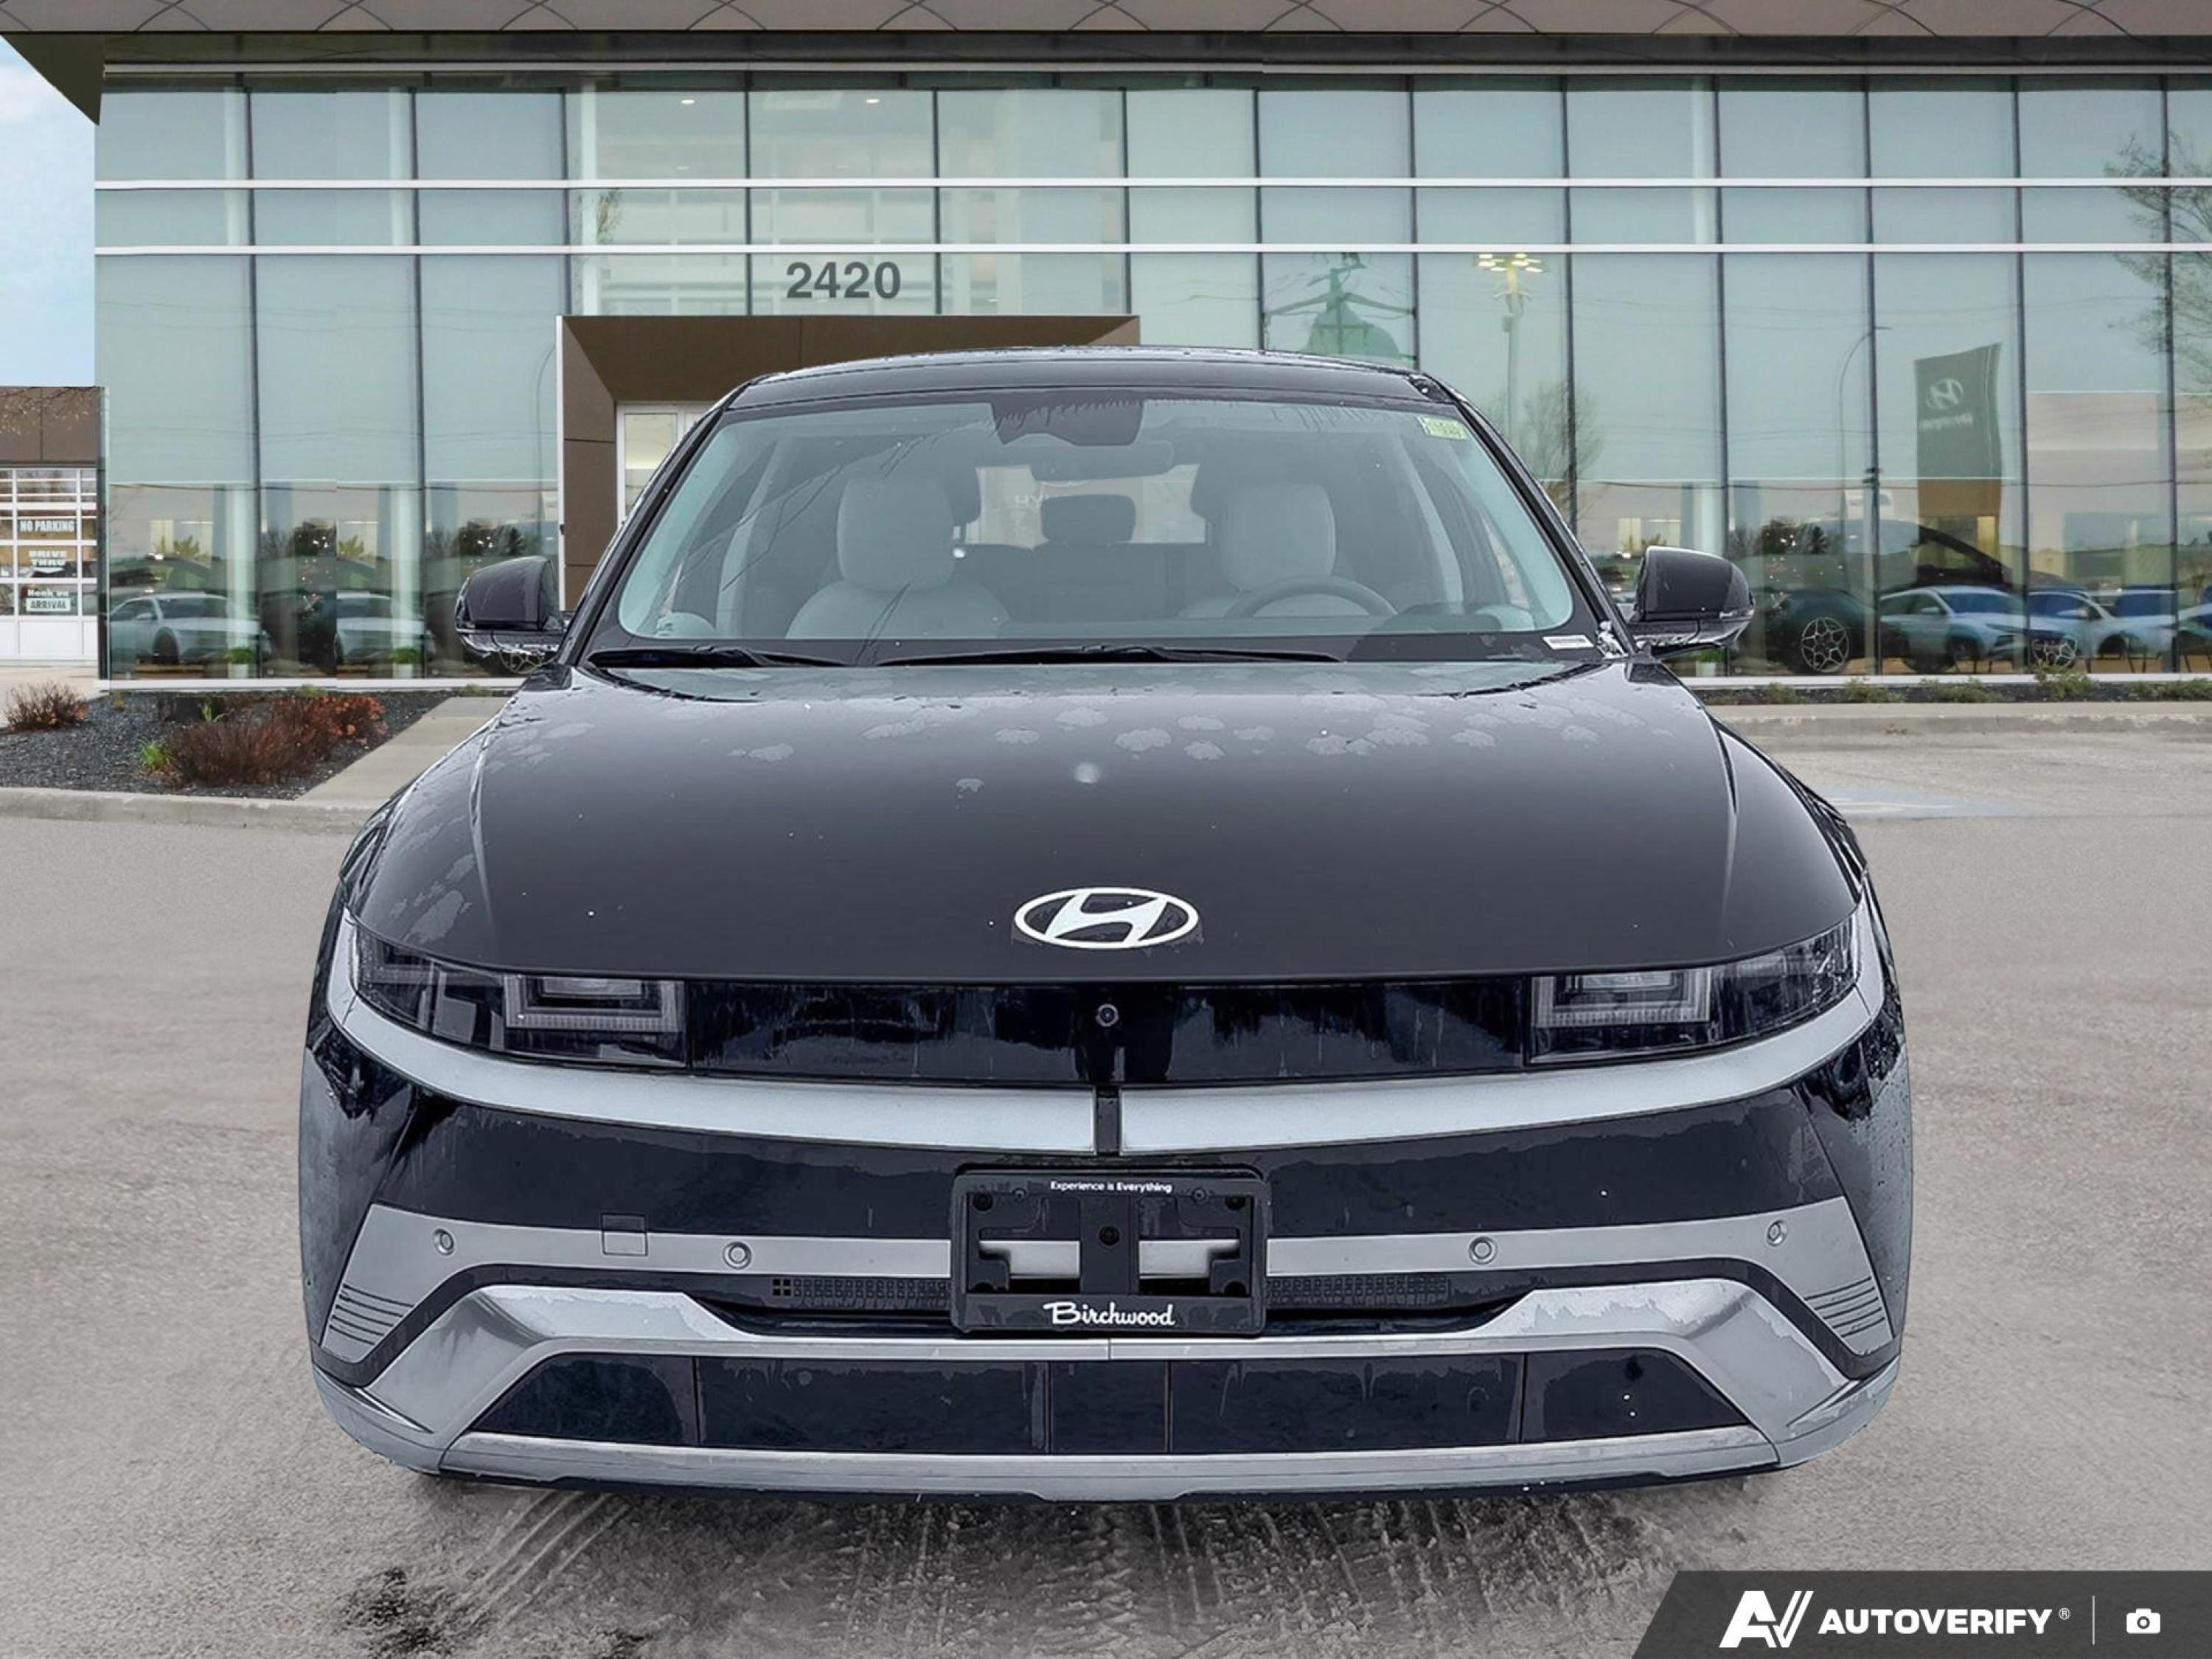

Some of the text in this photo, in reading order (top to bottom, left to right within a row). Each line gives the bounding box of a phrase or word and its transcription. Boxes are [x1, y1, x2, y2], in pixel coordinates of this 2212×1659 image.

[786, 261, 901, 299] 2420
[20, 520, 74, 532] NO PARKING
[28, 550, 67, 558] DRIVE
[31, 558, 66, 566] THRU
[30, 600, 67, 609] ARRIVAL
[1050, 1180, 1172, 1194] Experience is Everything
[1042, 1301, 1176, 1326] Birchwood
